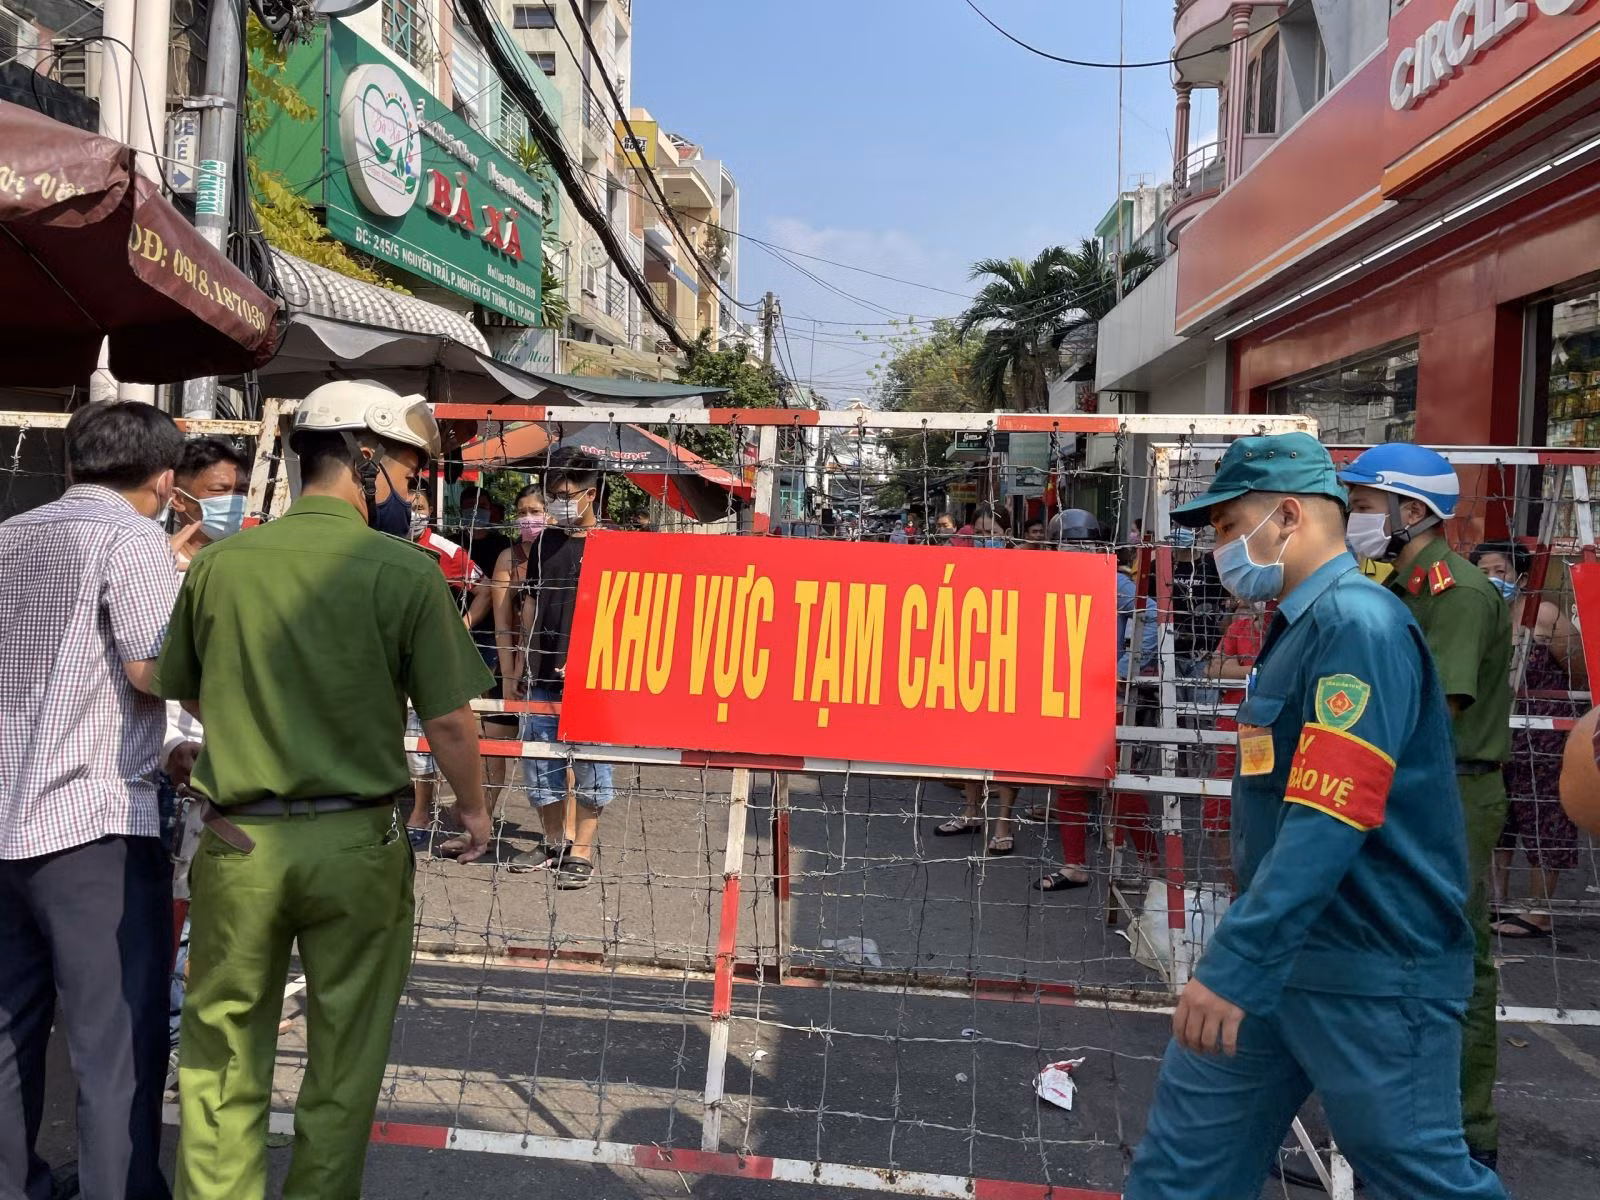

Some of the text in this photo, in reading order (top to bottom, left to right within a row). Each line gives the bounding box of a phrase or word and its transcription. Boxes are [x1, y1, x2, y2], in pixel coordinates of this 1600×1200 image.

[373, 234, 400, 259] 245/5
[586, 563, 1093, 728] KHU VỰC TẠM CÁCH LY
[1288, 758, 1354, 808] BẢO VỆ
